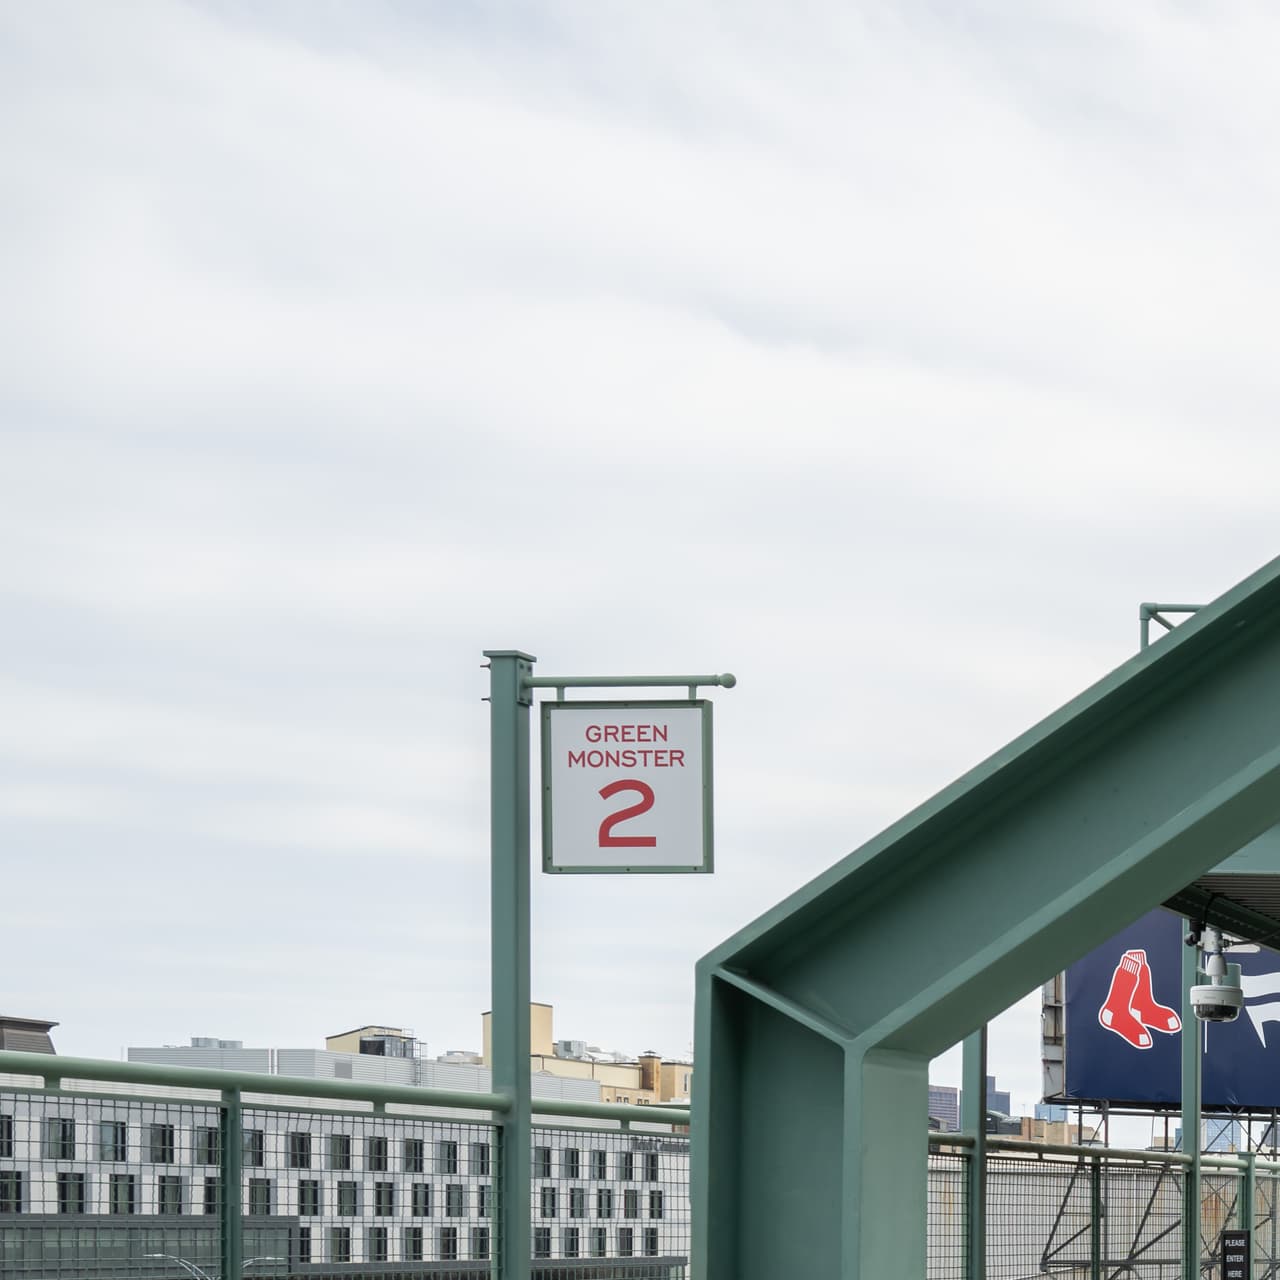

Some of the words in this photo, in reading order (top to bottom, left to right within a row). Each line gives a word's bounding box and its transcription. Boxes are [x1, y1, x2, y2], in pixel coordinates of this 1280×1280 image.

[585, 724, 668, 743] GREEN
[567, 749, 685, 768] MONSTER
[597, 778, 657, 848] 2
[1225, 1239, 1247, 1247] PLEASE
[1226, 1254, 1244, 1263] ENTER
[1227, 1270, 1243, 1278] HERE
